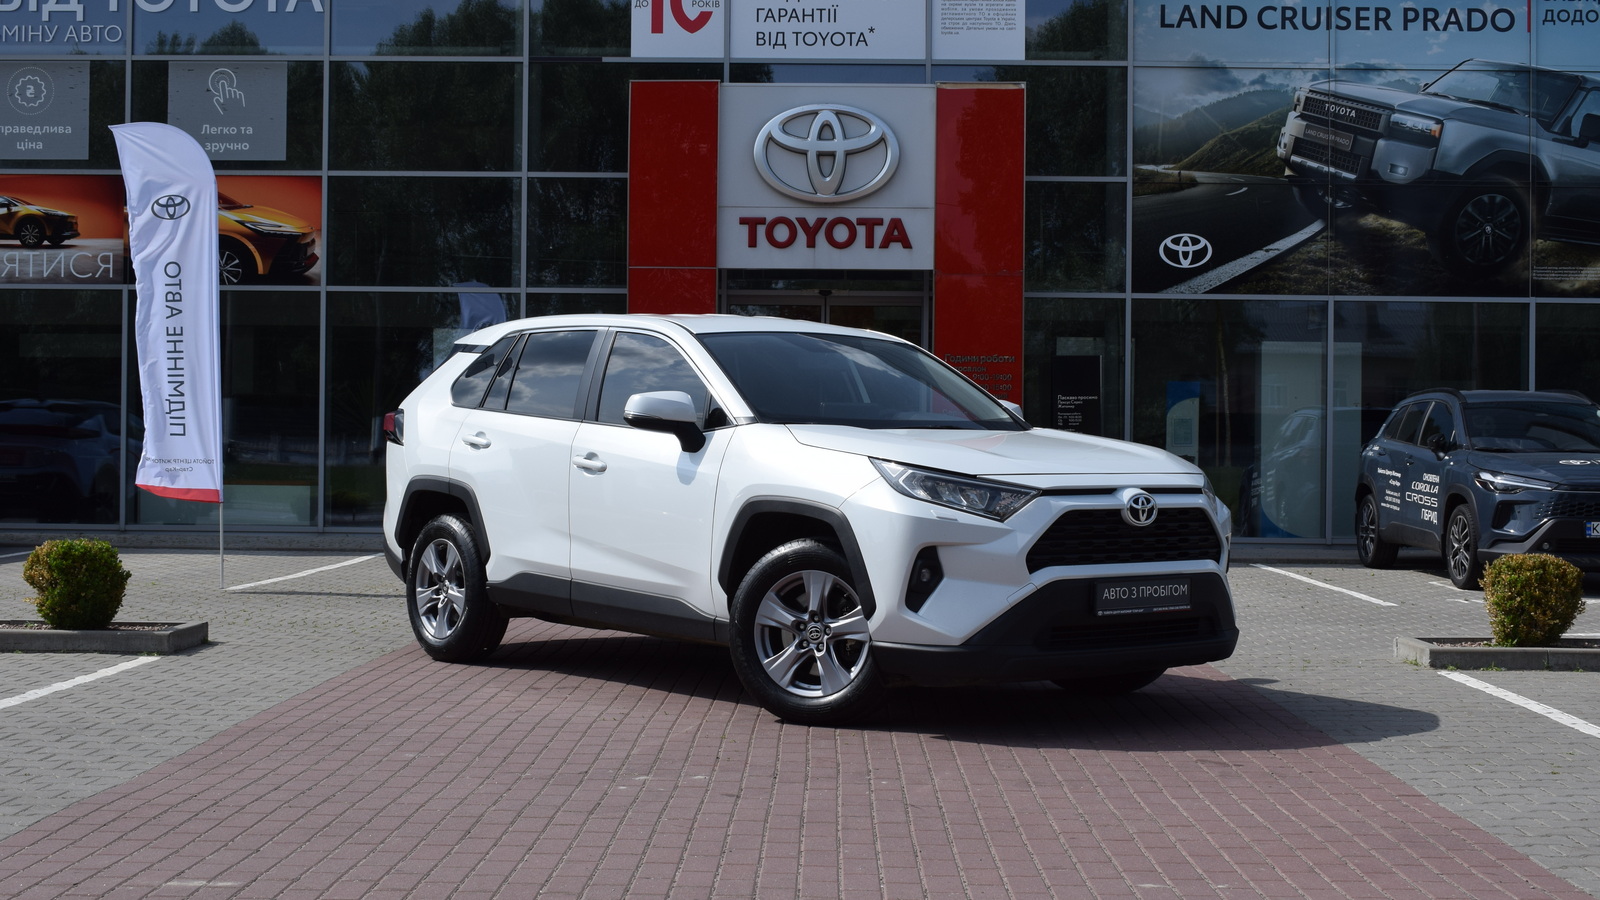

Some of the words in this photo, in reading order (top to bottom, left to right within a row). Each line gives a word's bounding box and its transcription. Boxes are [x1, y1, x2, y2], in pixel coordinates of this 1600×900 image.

[692, 0, 720, 8] РОКІВ
[756, 4, 838, 22] ГАРАНТІЇ
[1160, 4, 1248, 29] LAND
[1257, 6, 1392, 30] CRUISER
[1402, 8, 1516, 32] PRADO
[2, 25, 58, 42] МІНУ
[64, 24, 122, 42] АВТО
[756, 32, 786, 49] ВІД
[1325, 104, 1356, 118] TOYOTA
[200, 124, 237, 134] Легко
[240, 126, 253, 134] та
[16, 139, 43, 150] ціна
[1317, 132, 1335, 140] CRUISER
[1335, 136, 1350, 145] PRADO
[204, 142, 250, 152] зручно
[738, 216, 912, 249] TOYOTA
[2, 252, 113, 278] ЯТИСЯ
[944, 354, 979, 363] Години
[980, 354, 1015, 364] роботи
[1412, 481, 1439, 494] COROLLA
[1405, 492, 1438, 507] CROSS
[1102, 587, 1128, 600] АВТО
[1140, 584, 1188, 597] ПРОБІГОМ
